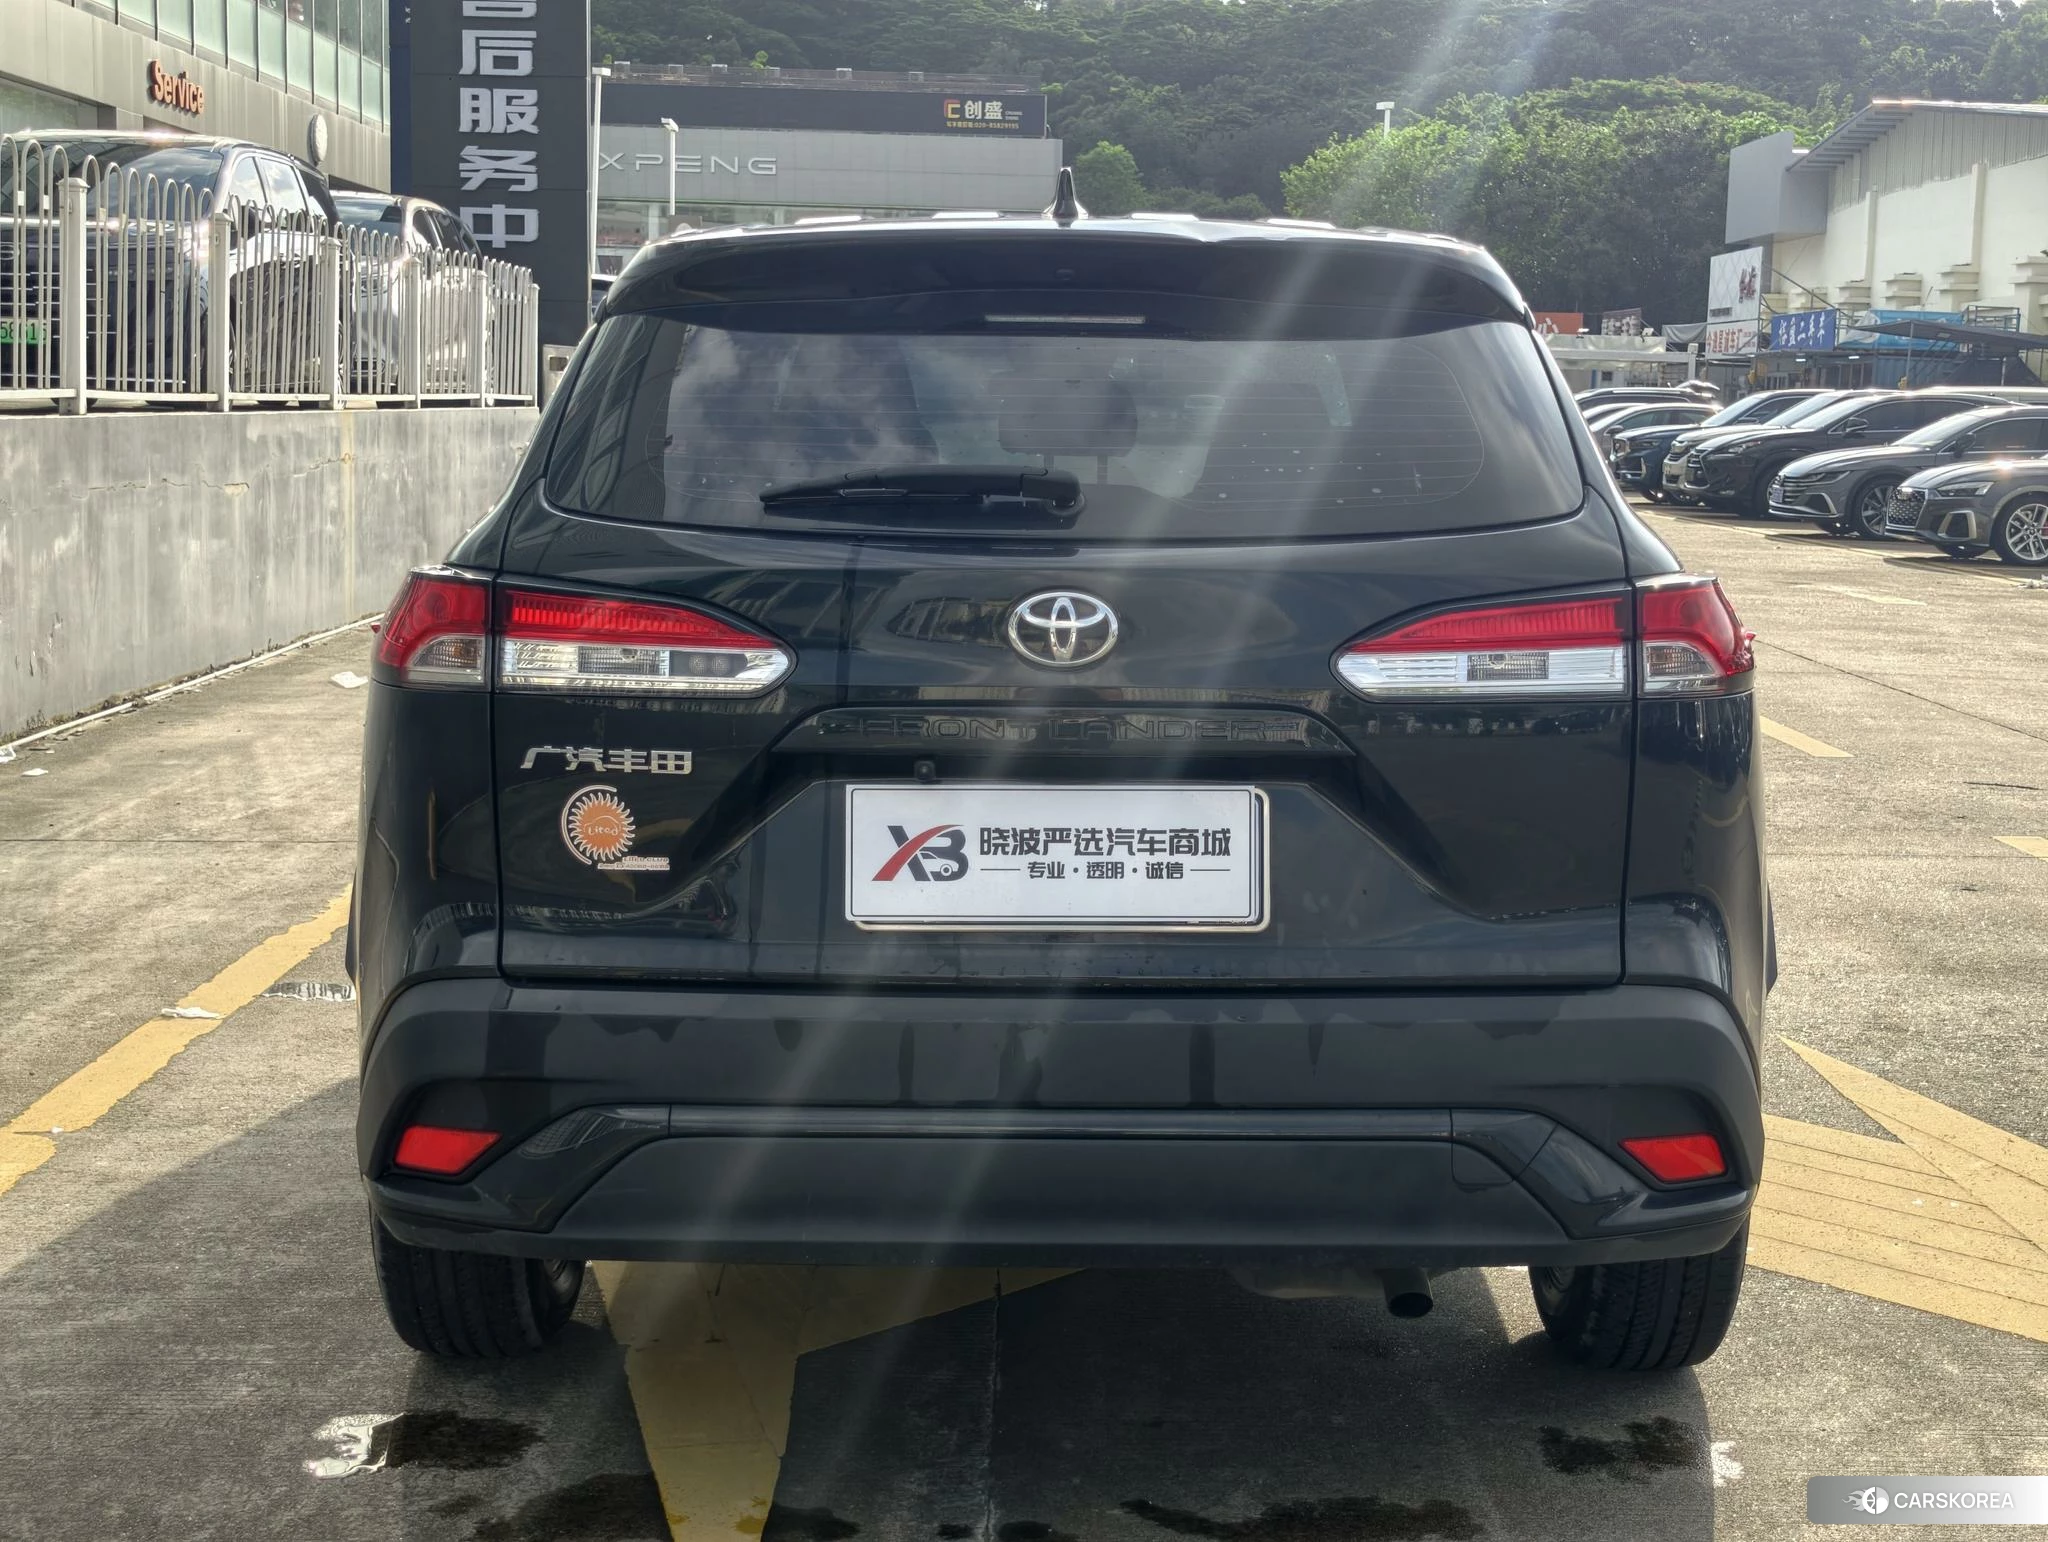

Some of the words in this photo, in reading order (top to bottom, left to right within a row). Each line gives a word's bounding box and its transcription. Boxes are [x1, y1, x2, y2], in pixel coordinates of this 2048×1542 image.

[150, 59, 204, 113] Service
[964, 100, 1003, 120] 创盛
[598, 152, 777, 175] XPENG
[520, 745, 693, 775] 广汽丰田
[979, 827, 1232, 857] 晓波严选汽车商城
